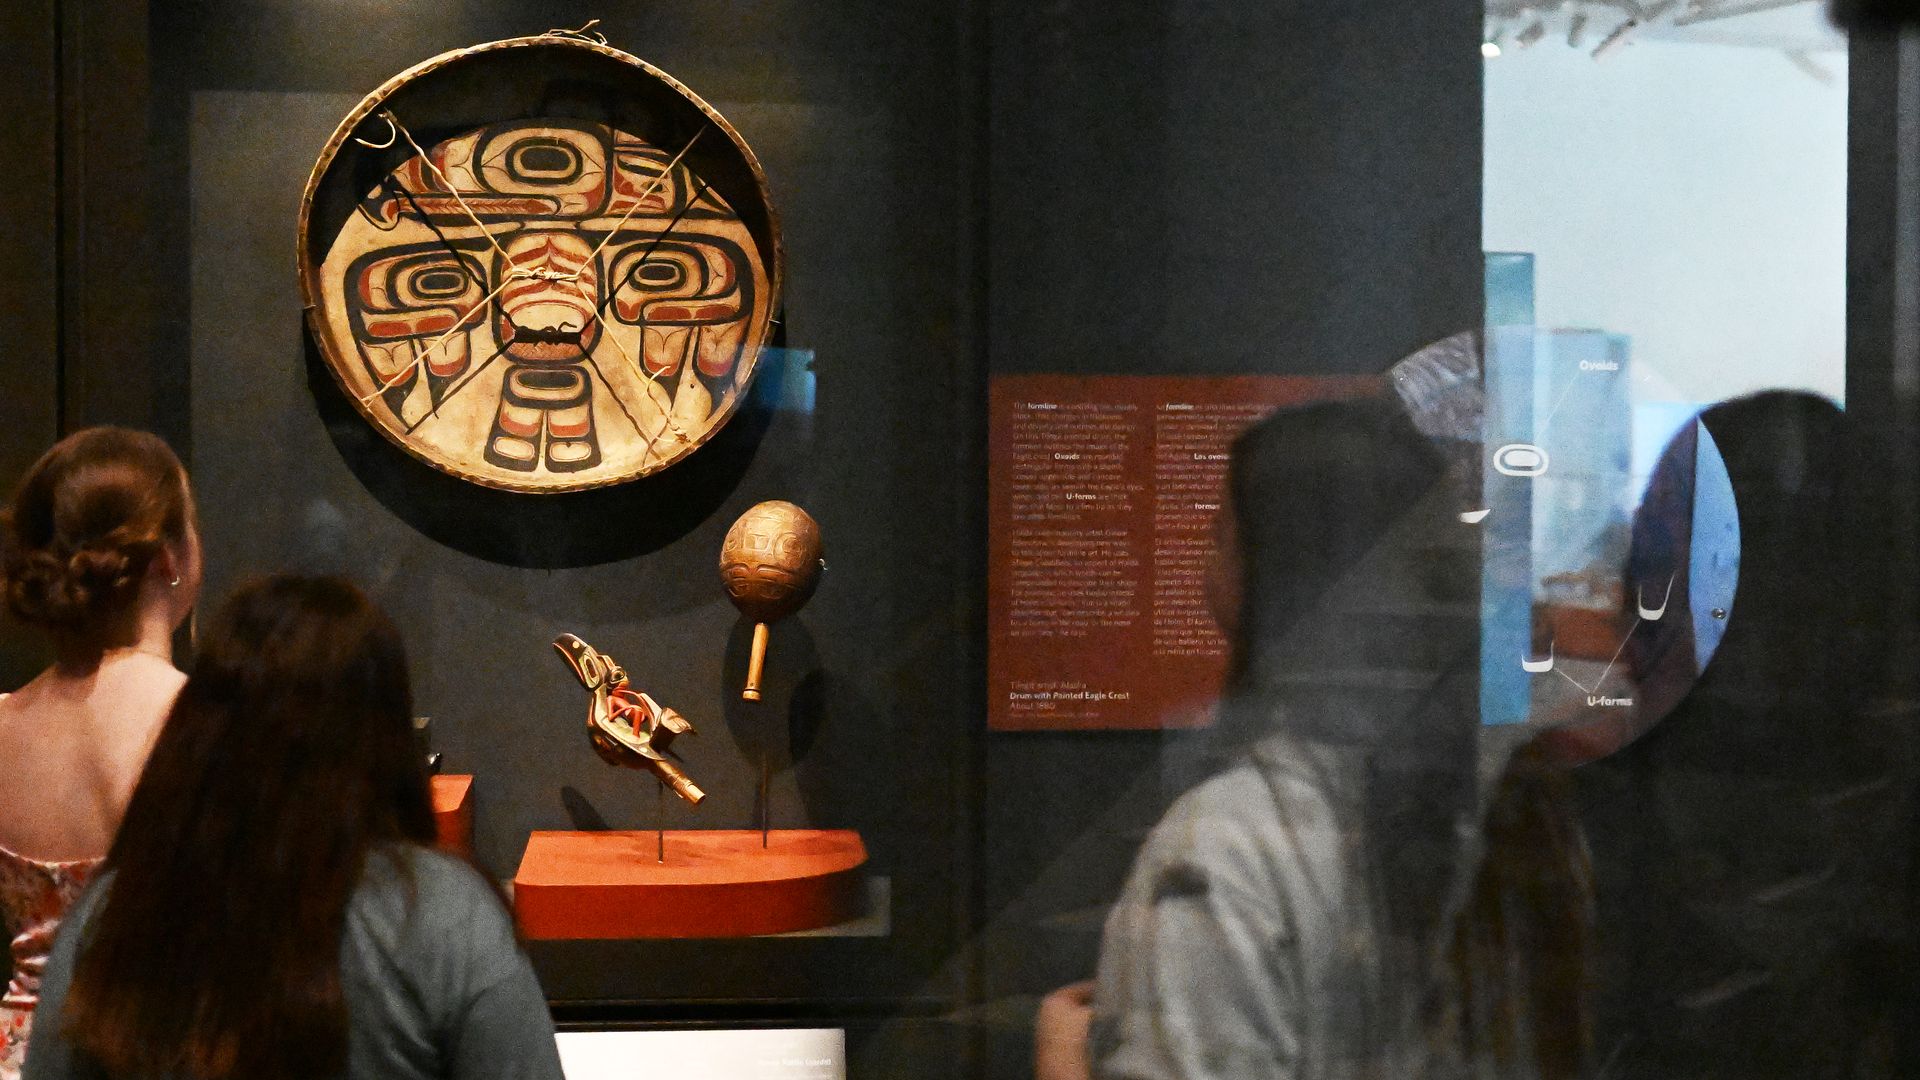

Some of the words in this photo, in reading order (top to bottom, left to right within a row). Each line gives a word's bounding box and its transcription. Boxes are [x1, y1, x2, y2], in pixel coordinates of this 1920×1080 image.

[1580, 360, 1618, 370] Ovoids
[1028, 402, 1057, 411] formline
[1055, 452, 1080, 461] Ovoids
[1194, 453, 1206, 461] Los
[1066, 493, 1097, 501] U-forms
[1009, 691, 1032, 700] Drum
[1034, 691, 1051, 700] with
[1053, 691, 1084, 700] Painted
[1084, 691, 1107, 701] Eagle
[1108, 691, 1130, 700] Crest
[1586, 696, 1633, 707] U-forms
